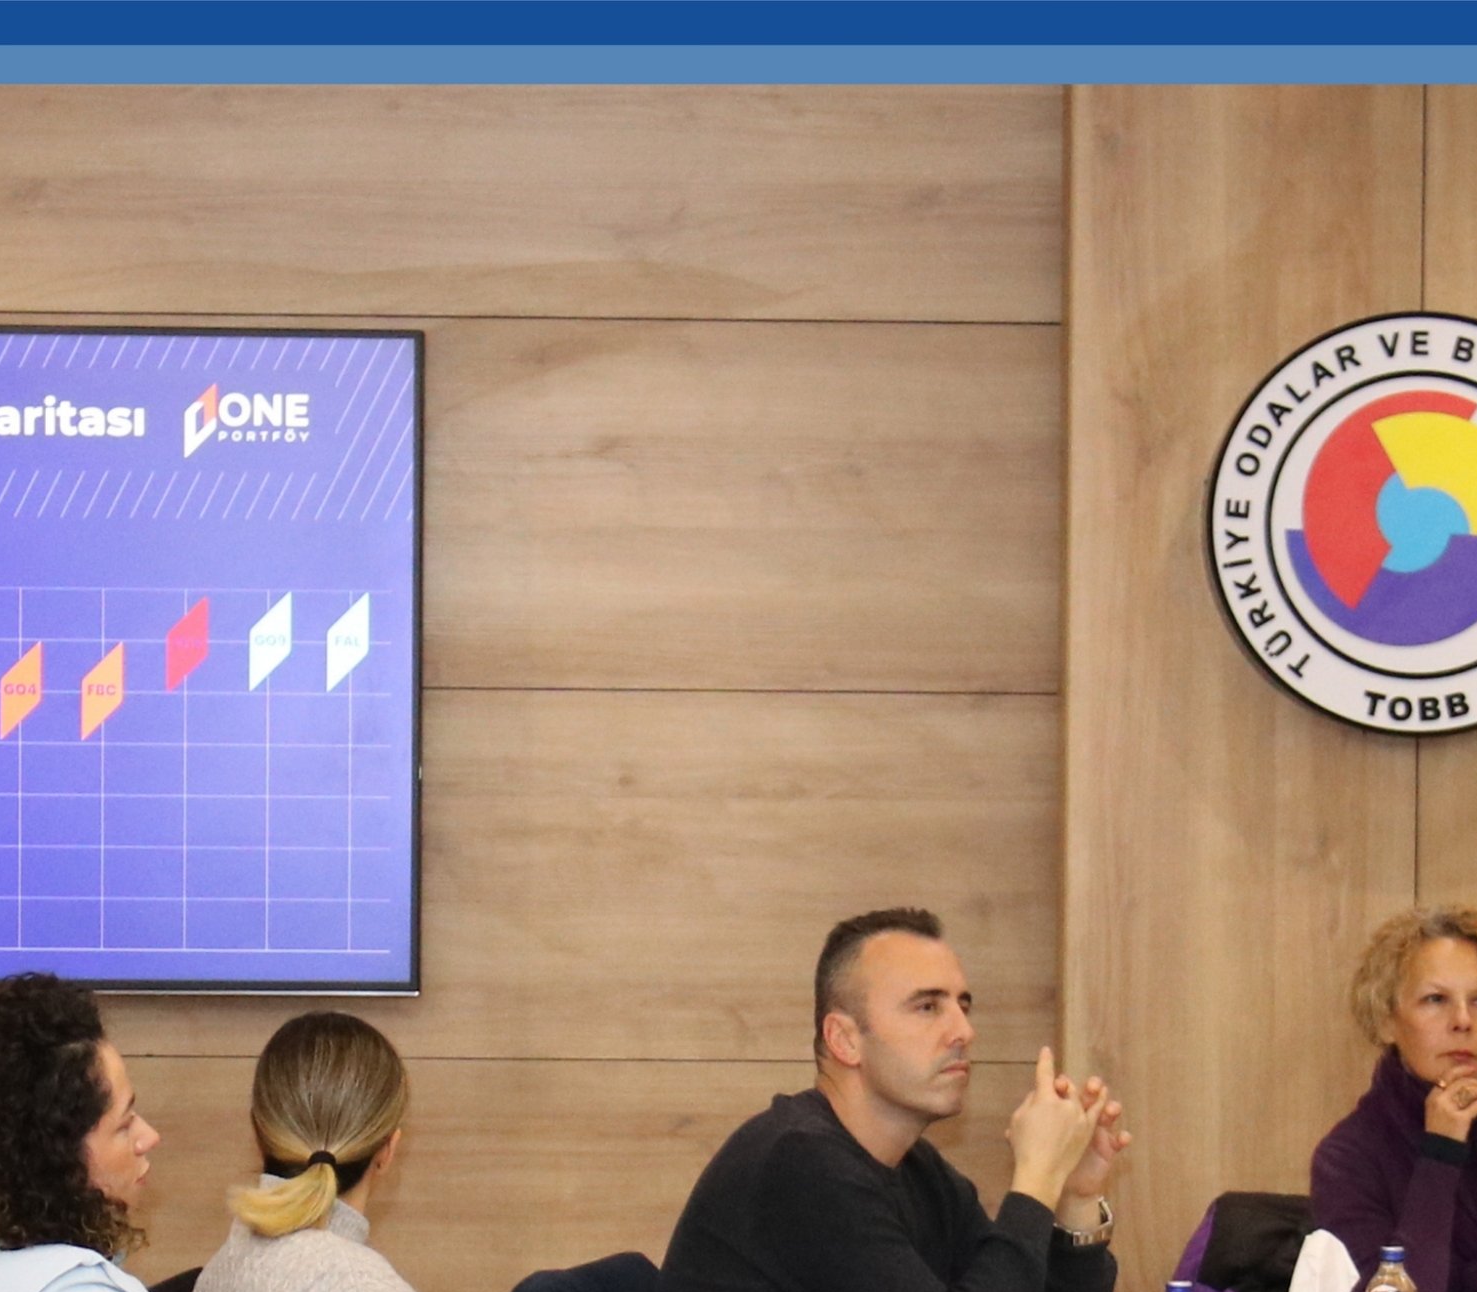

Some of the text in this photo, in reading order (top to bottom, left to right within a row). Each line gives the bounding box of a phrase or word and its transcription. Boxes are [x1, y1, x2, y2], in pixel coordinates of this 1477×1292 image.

[1378, 331, 1430, 358] VE
[218, 392, 310, 427] ONE
[1235, 345, 1362, 477] ODALAR
[218, 428, 310, 443] PORTFÖY
[1222, 499, 1313, 679] TÜRKİYE
[1363, 691, 1470, 722] TOBB
